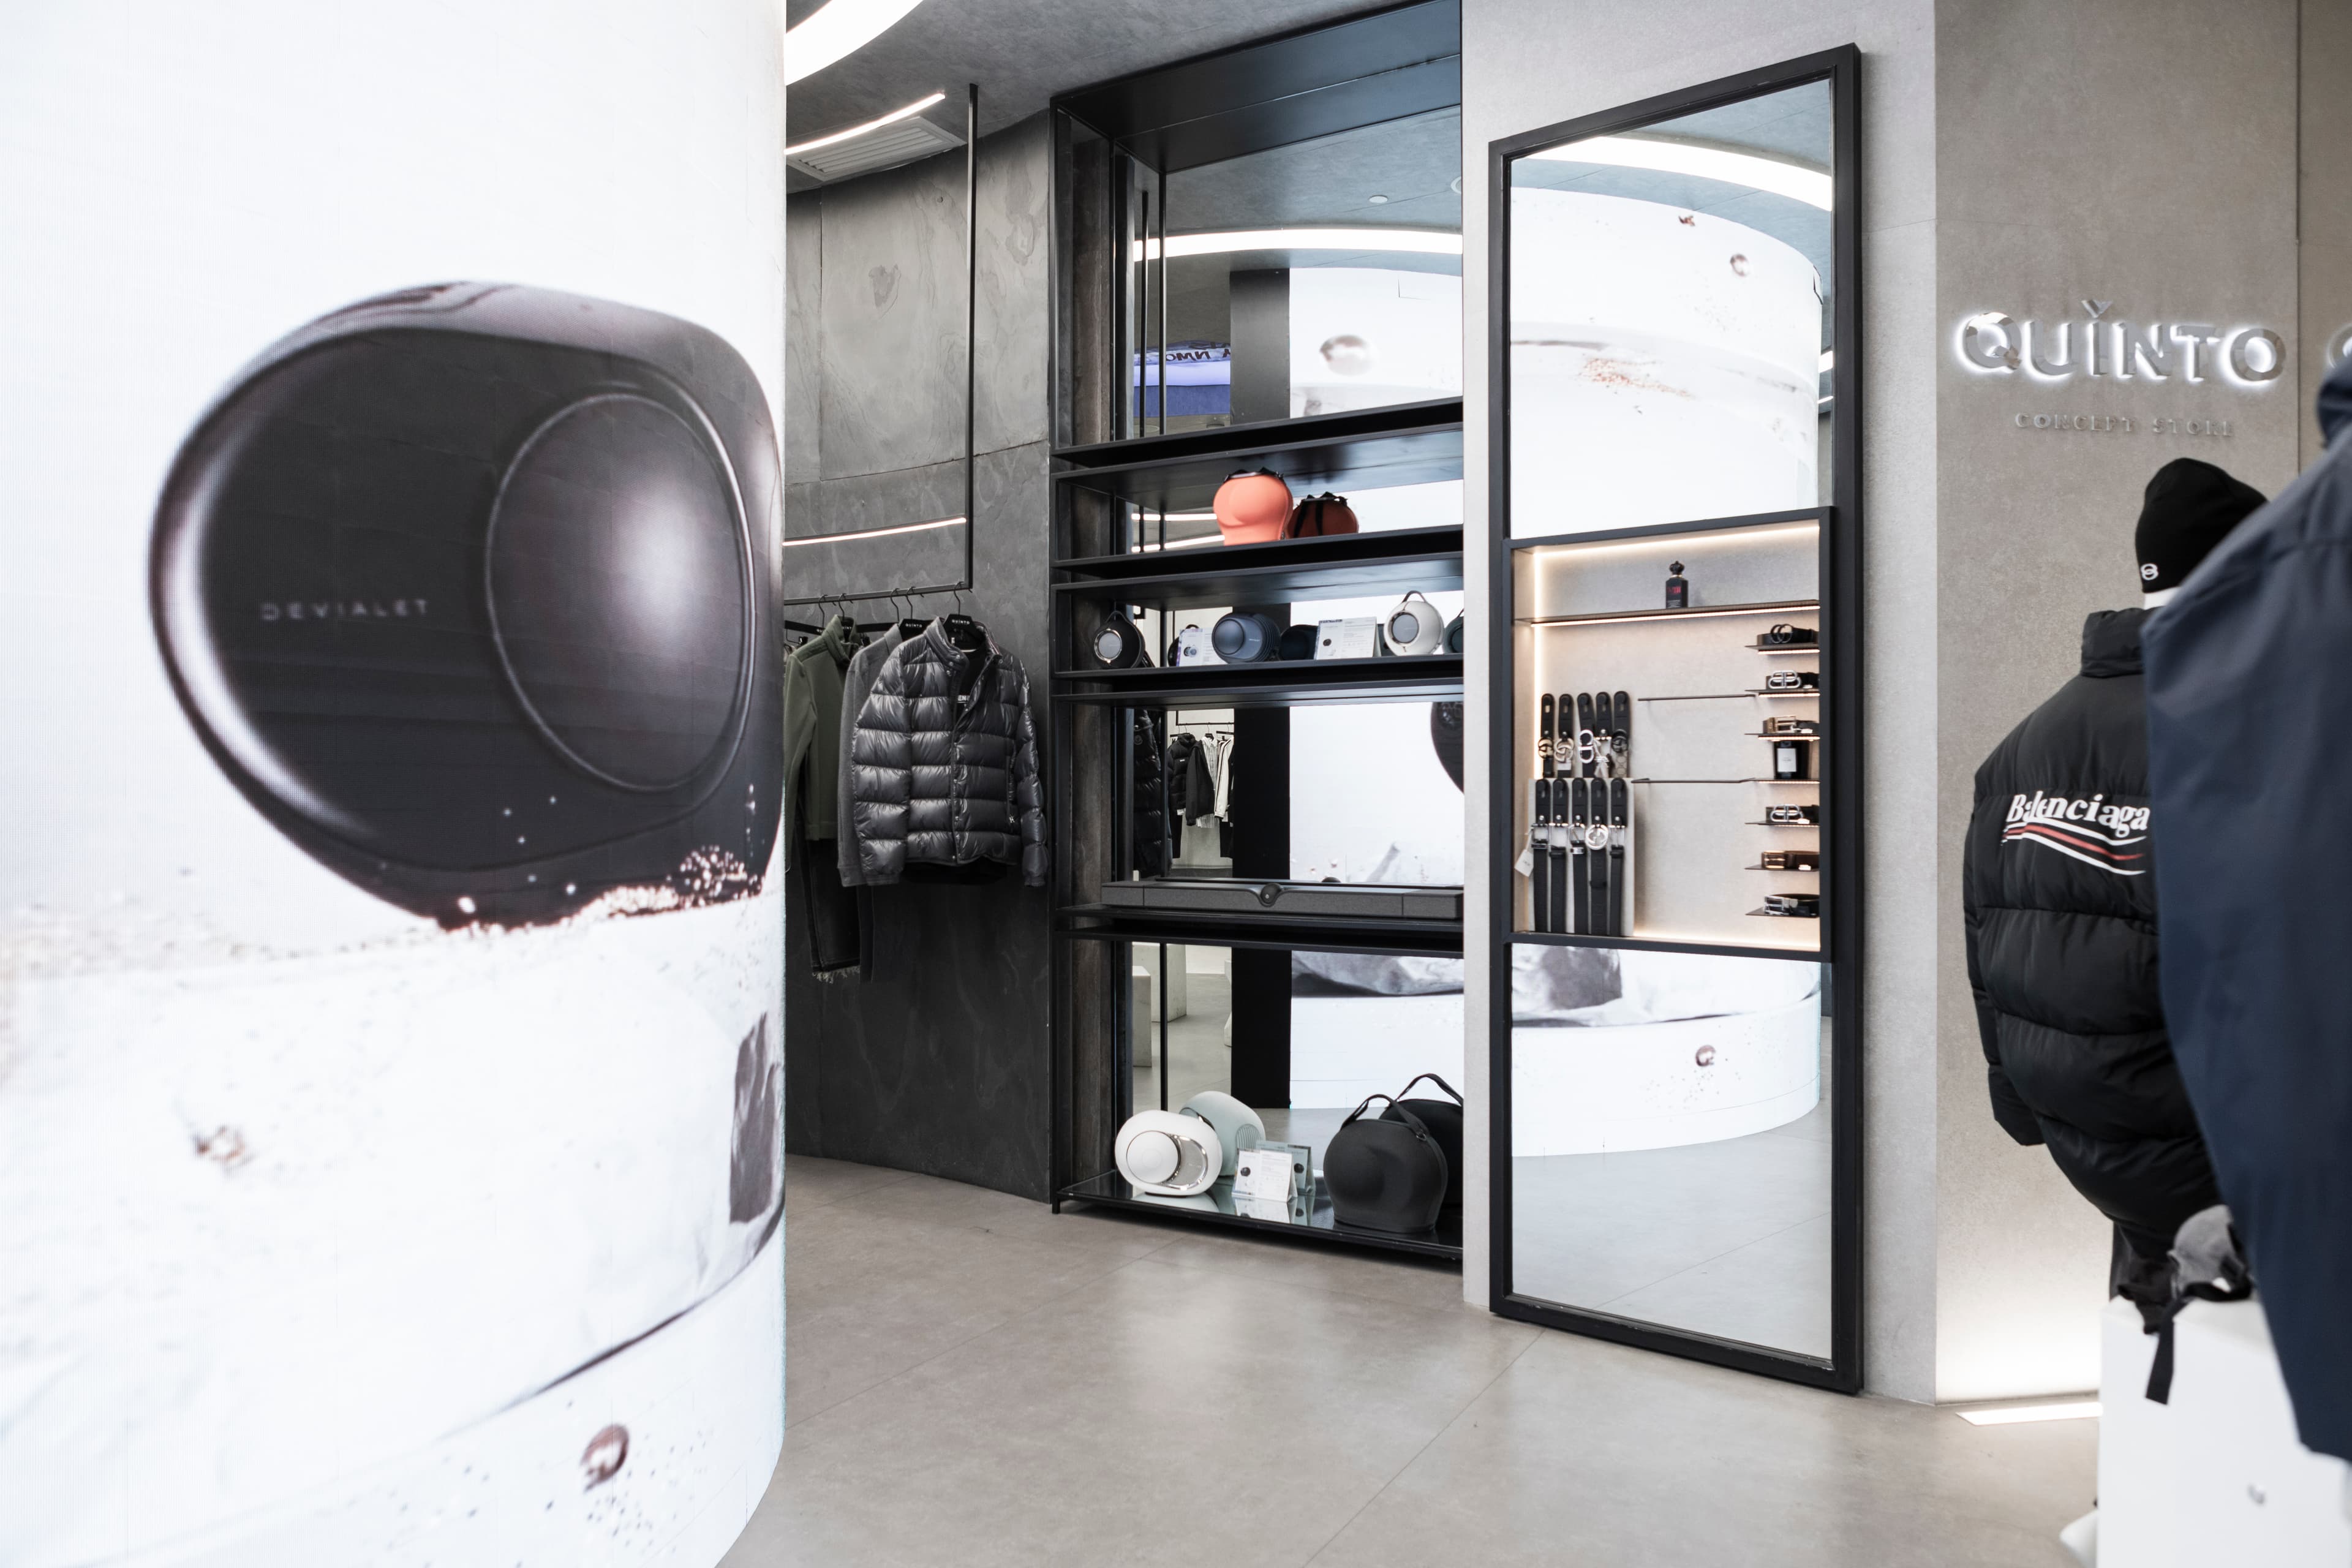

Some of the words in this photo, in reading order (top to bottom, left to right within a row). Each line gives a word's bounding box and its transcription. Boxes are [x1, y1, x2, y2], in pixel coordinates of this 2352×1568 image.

[2015, 412, 2136, 432] CONCEPT
[2152, 417, 2235, 437] STORE
[261, 598, 428, 621] DEVIALET
[2006, 790, 2150, 838] Balenciaga
